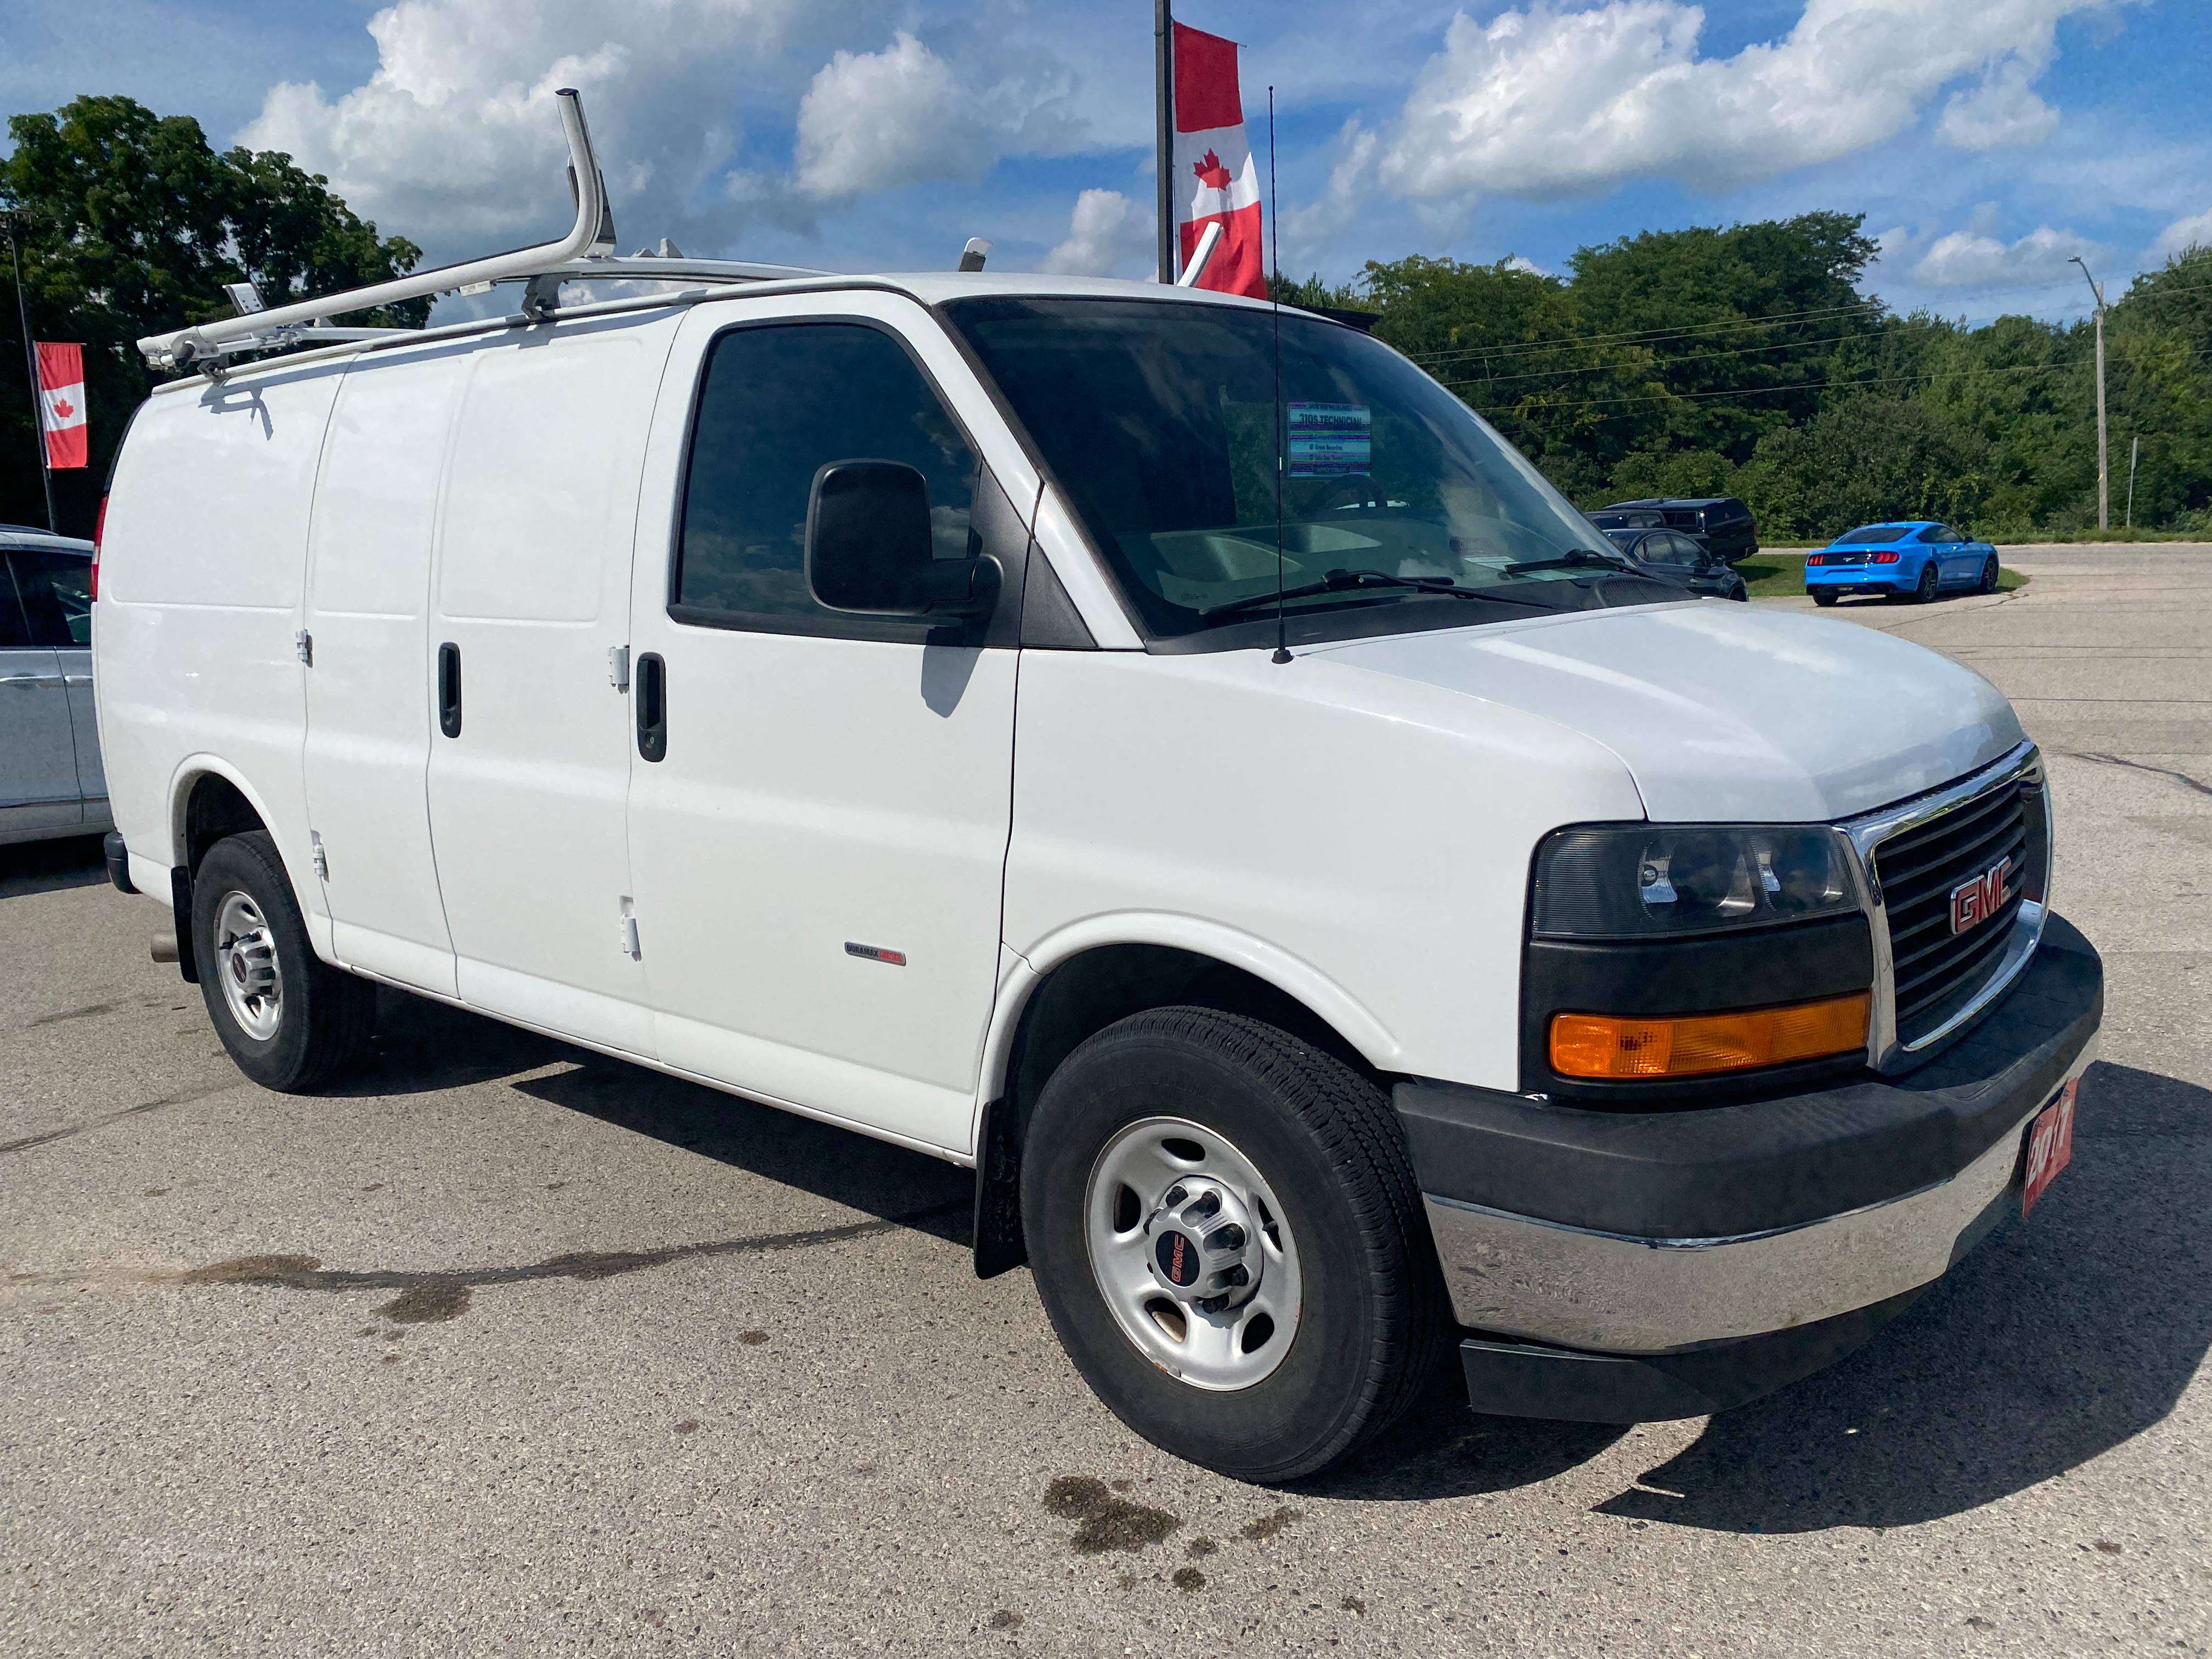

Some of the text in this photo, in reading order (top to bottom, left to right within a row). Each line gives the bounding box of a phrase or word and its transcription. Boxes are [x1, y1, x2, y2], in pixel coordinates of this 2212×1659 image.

[1299, 414, 1361, 426] 310S TECHNICIAN
[1950, 855, 2012, 935] GMC
[847, 944, 879, 957] DURAMAX
[2027, 1098, 2072, 1189] 2017
[1171, 1235, 1184, 1283] GMC
